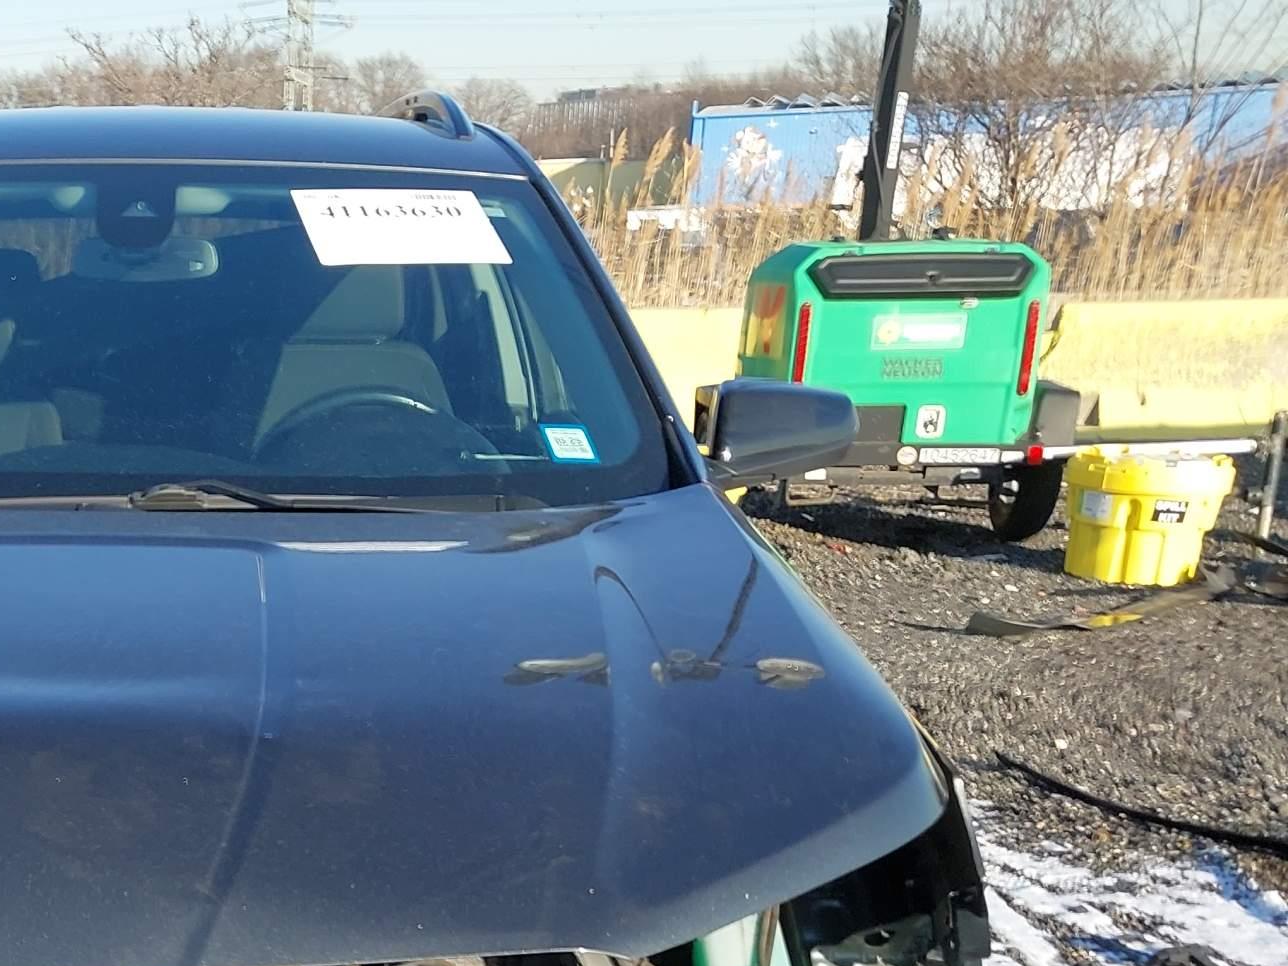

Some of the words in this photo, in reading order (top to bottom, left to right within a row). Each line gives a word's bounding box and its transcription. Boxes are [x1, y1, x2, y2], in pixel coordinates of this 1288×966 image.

[319, 205, 462, 218] 41163630
[883, 358, 943, 368] WACKER
[881, 368, 943, 378] NEUSON
